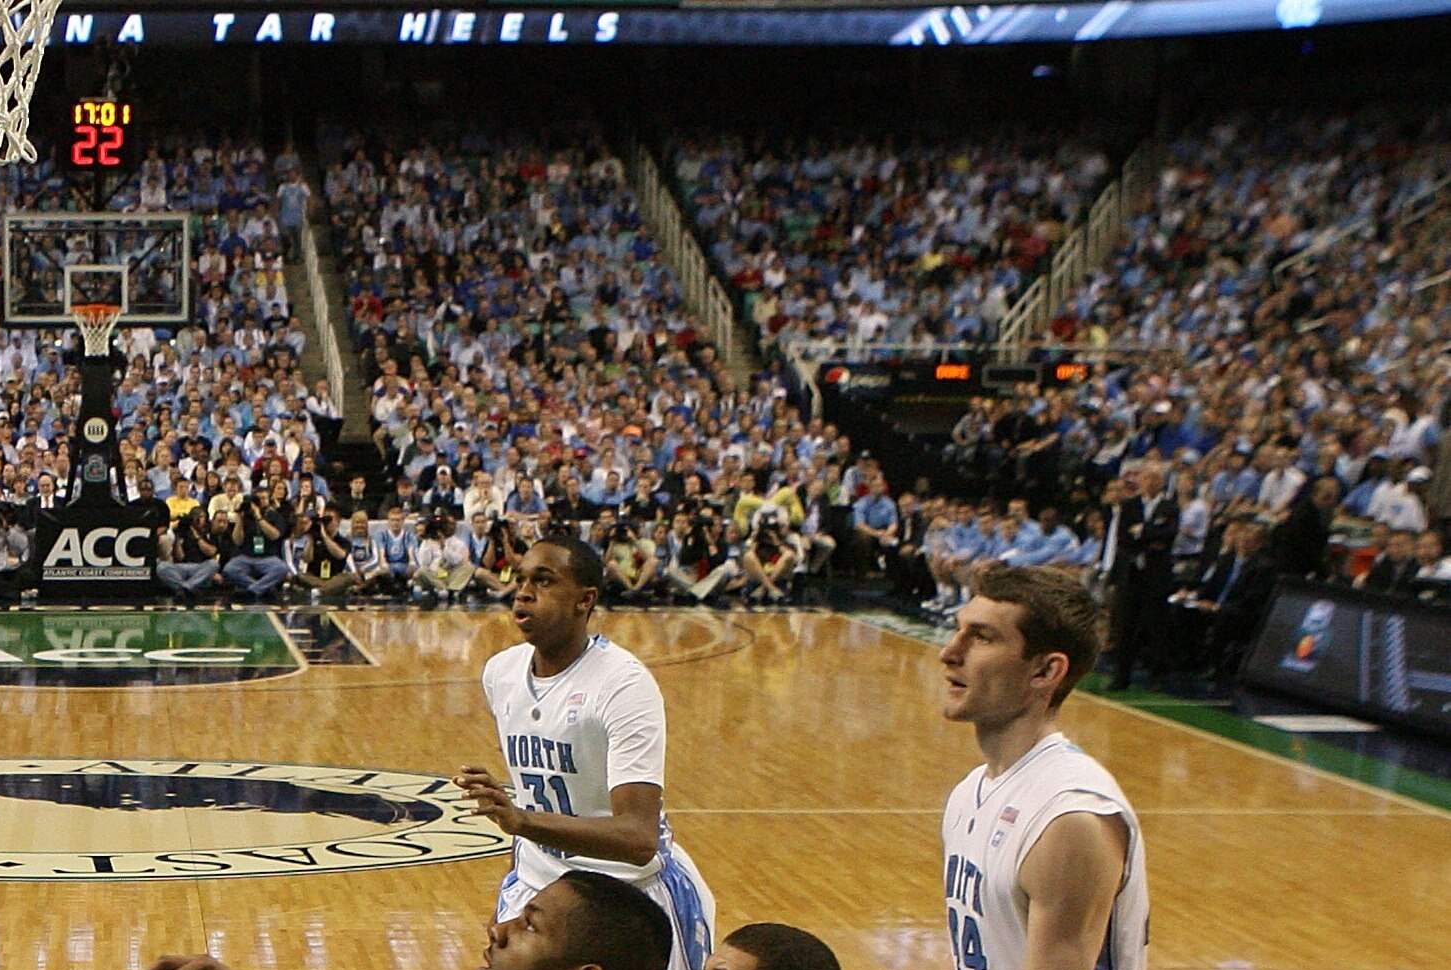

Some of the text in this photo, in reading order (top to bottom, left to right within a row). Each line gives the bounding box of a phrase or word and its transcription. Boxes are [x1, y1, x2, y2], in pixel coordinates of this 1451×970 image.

[213, 12, 336, 42] TAR
[399, 11, 620, 43] HEELS
[75, 102, 130, 126] 17:01
[71, 125, 124, 165] 22
[43, 527, 150, 568] ACC
[507, 735, 578, 774] NORTH
